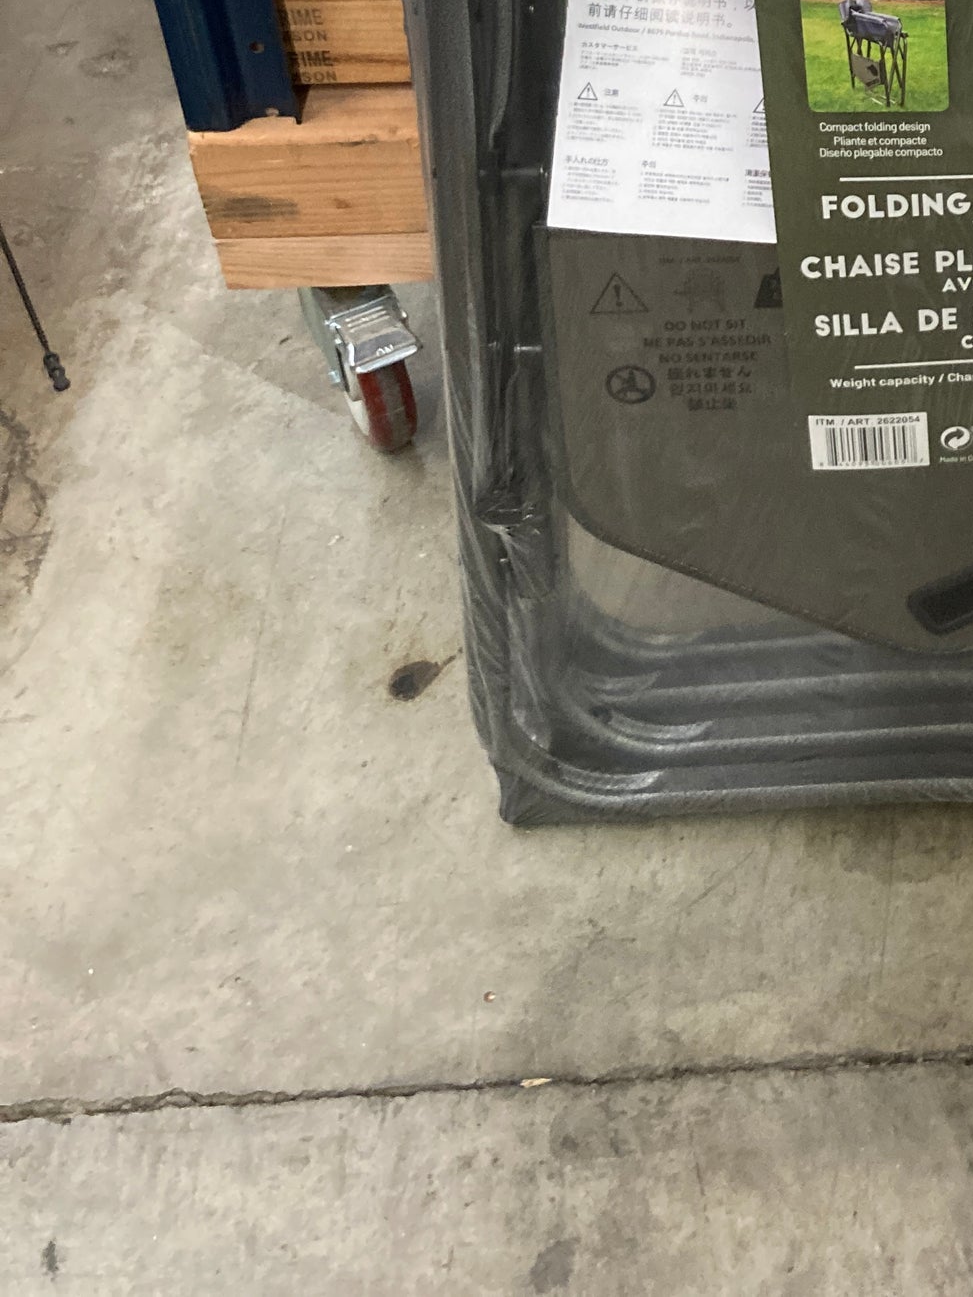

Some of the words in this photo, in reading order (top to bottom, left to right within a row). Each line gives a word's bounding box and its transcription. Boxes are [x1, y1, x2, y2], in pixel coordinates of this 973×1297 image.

[820, 122, 863, 133] Compact
[864, 122, 898, 133] folding
[899, 121, 931, 133] design
[833, 136, 867, 146] Pliante
[868, 136, 878, 146] et
[879, 136, 928, 148] compacte
[819, 148, 853, 157] Diseño
[853, 148, 894, 159] plegable
[895, 148, 944, 158] compacto
[821, 191, 972, 220] FOLDING
[800, 252, 920, 279] CHAISE
[814, 311, 904, 337] SILLA
[918, 307, 958, 332] DE
[829, 377, 876, 390] Weight
[878, 373, 936, 388] capacity
[877, 414, 921, 425] 2622054
